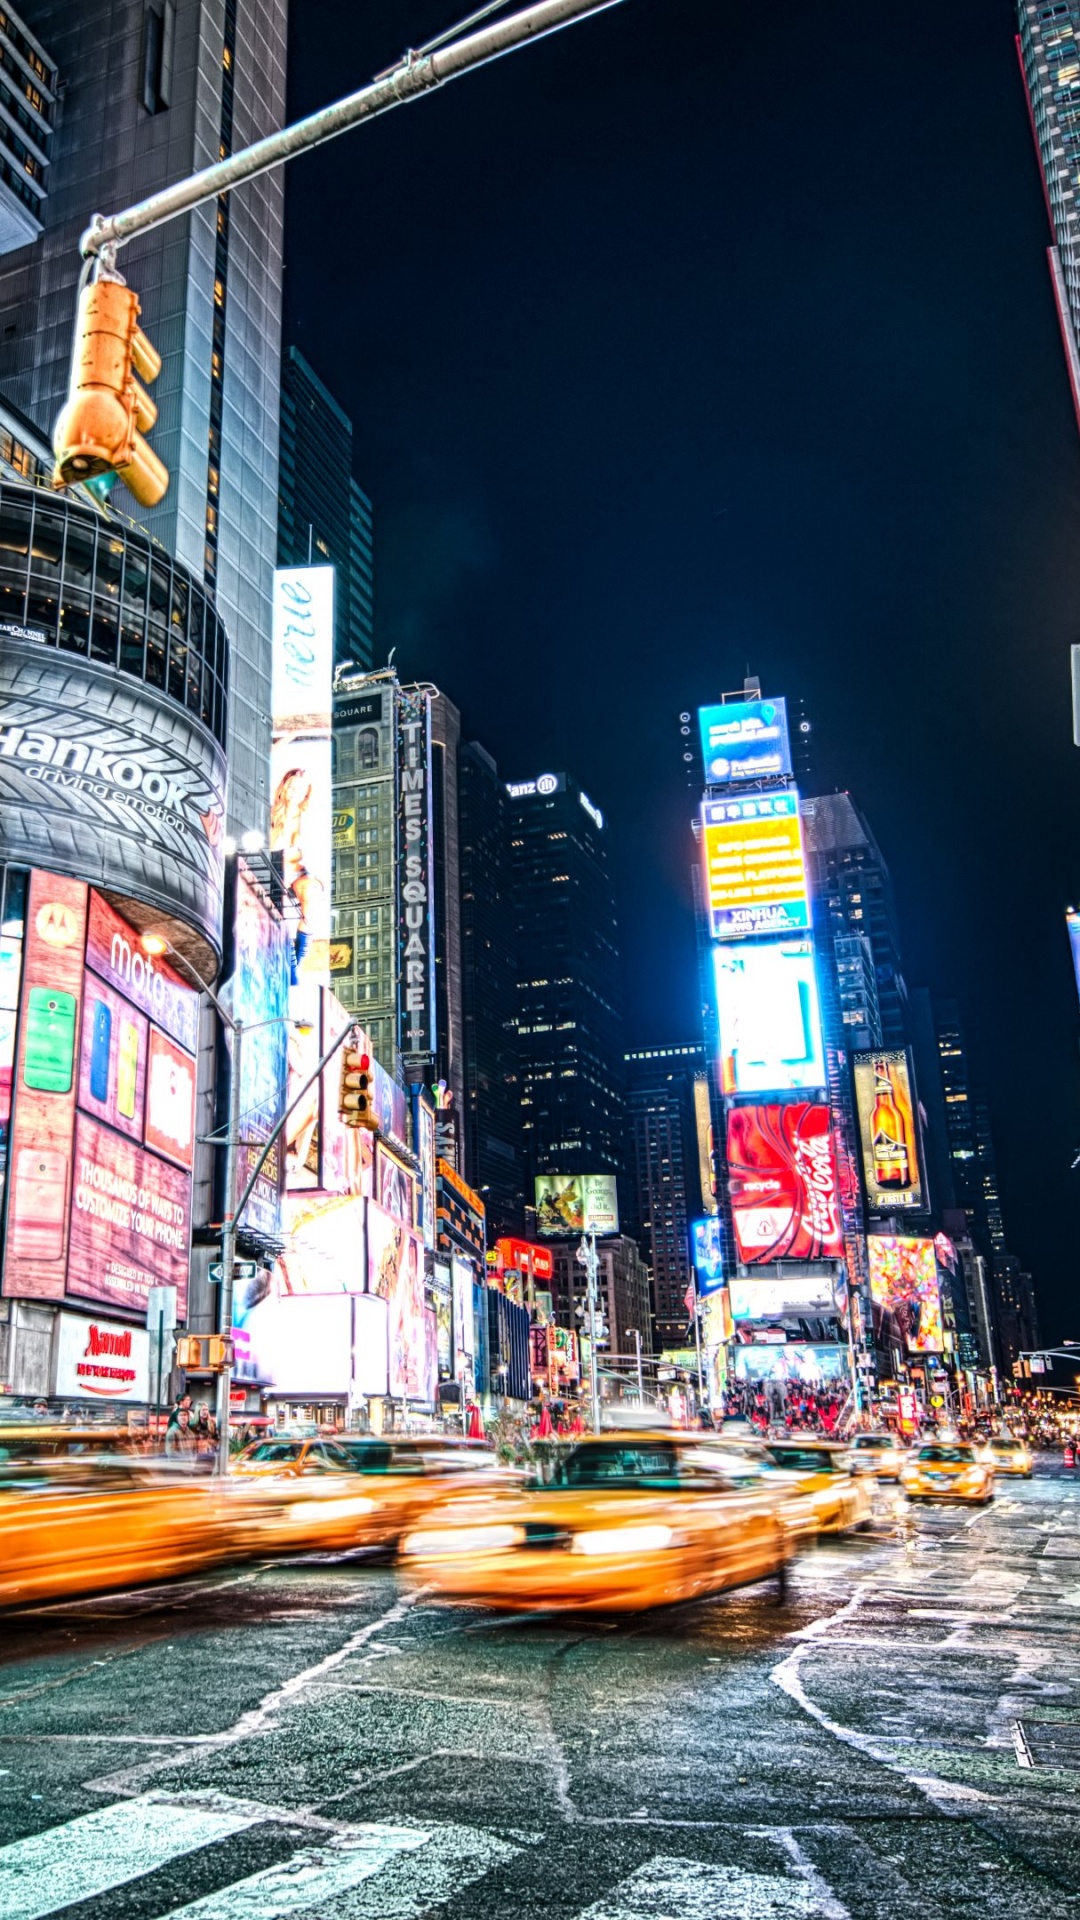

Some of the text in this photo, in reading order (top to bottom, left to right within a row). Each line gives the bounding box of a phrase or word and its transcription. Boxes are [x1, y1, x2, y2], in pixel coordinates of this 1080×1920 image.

[334, 704, 373, 719] SQUARE
[25, 766, 185, 833] driving emotion
[402, 722, 426, 1011] TIMES SQUARE
[719, 917, 801, 933] NEWS AGENCY
[731, 905, 788, 922] XINHUA
[111, 933, 165, 1007] moto
[407, 1029, 424, 1038] NYC
[80, 1158, 184, 1225] THOUSANDS OF WAYS TO
[743, 1179, 780, 1192] recycle
[76, 1185, 185, 1250] CUSTOMIZE YOUR PHONE.
[84, 1324, 132, 1357] Marriott
